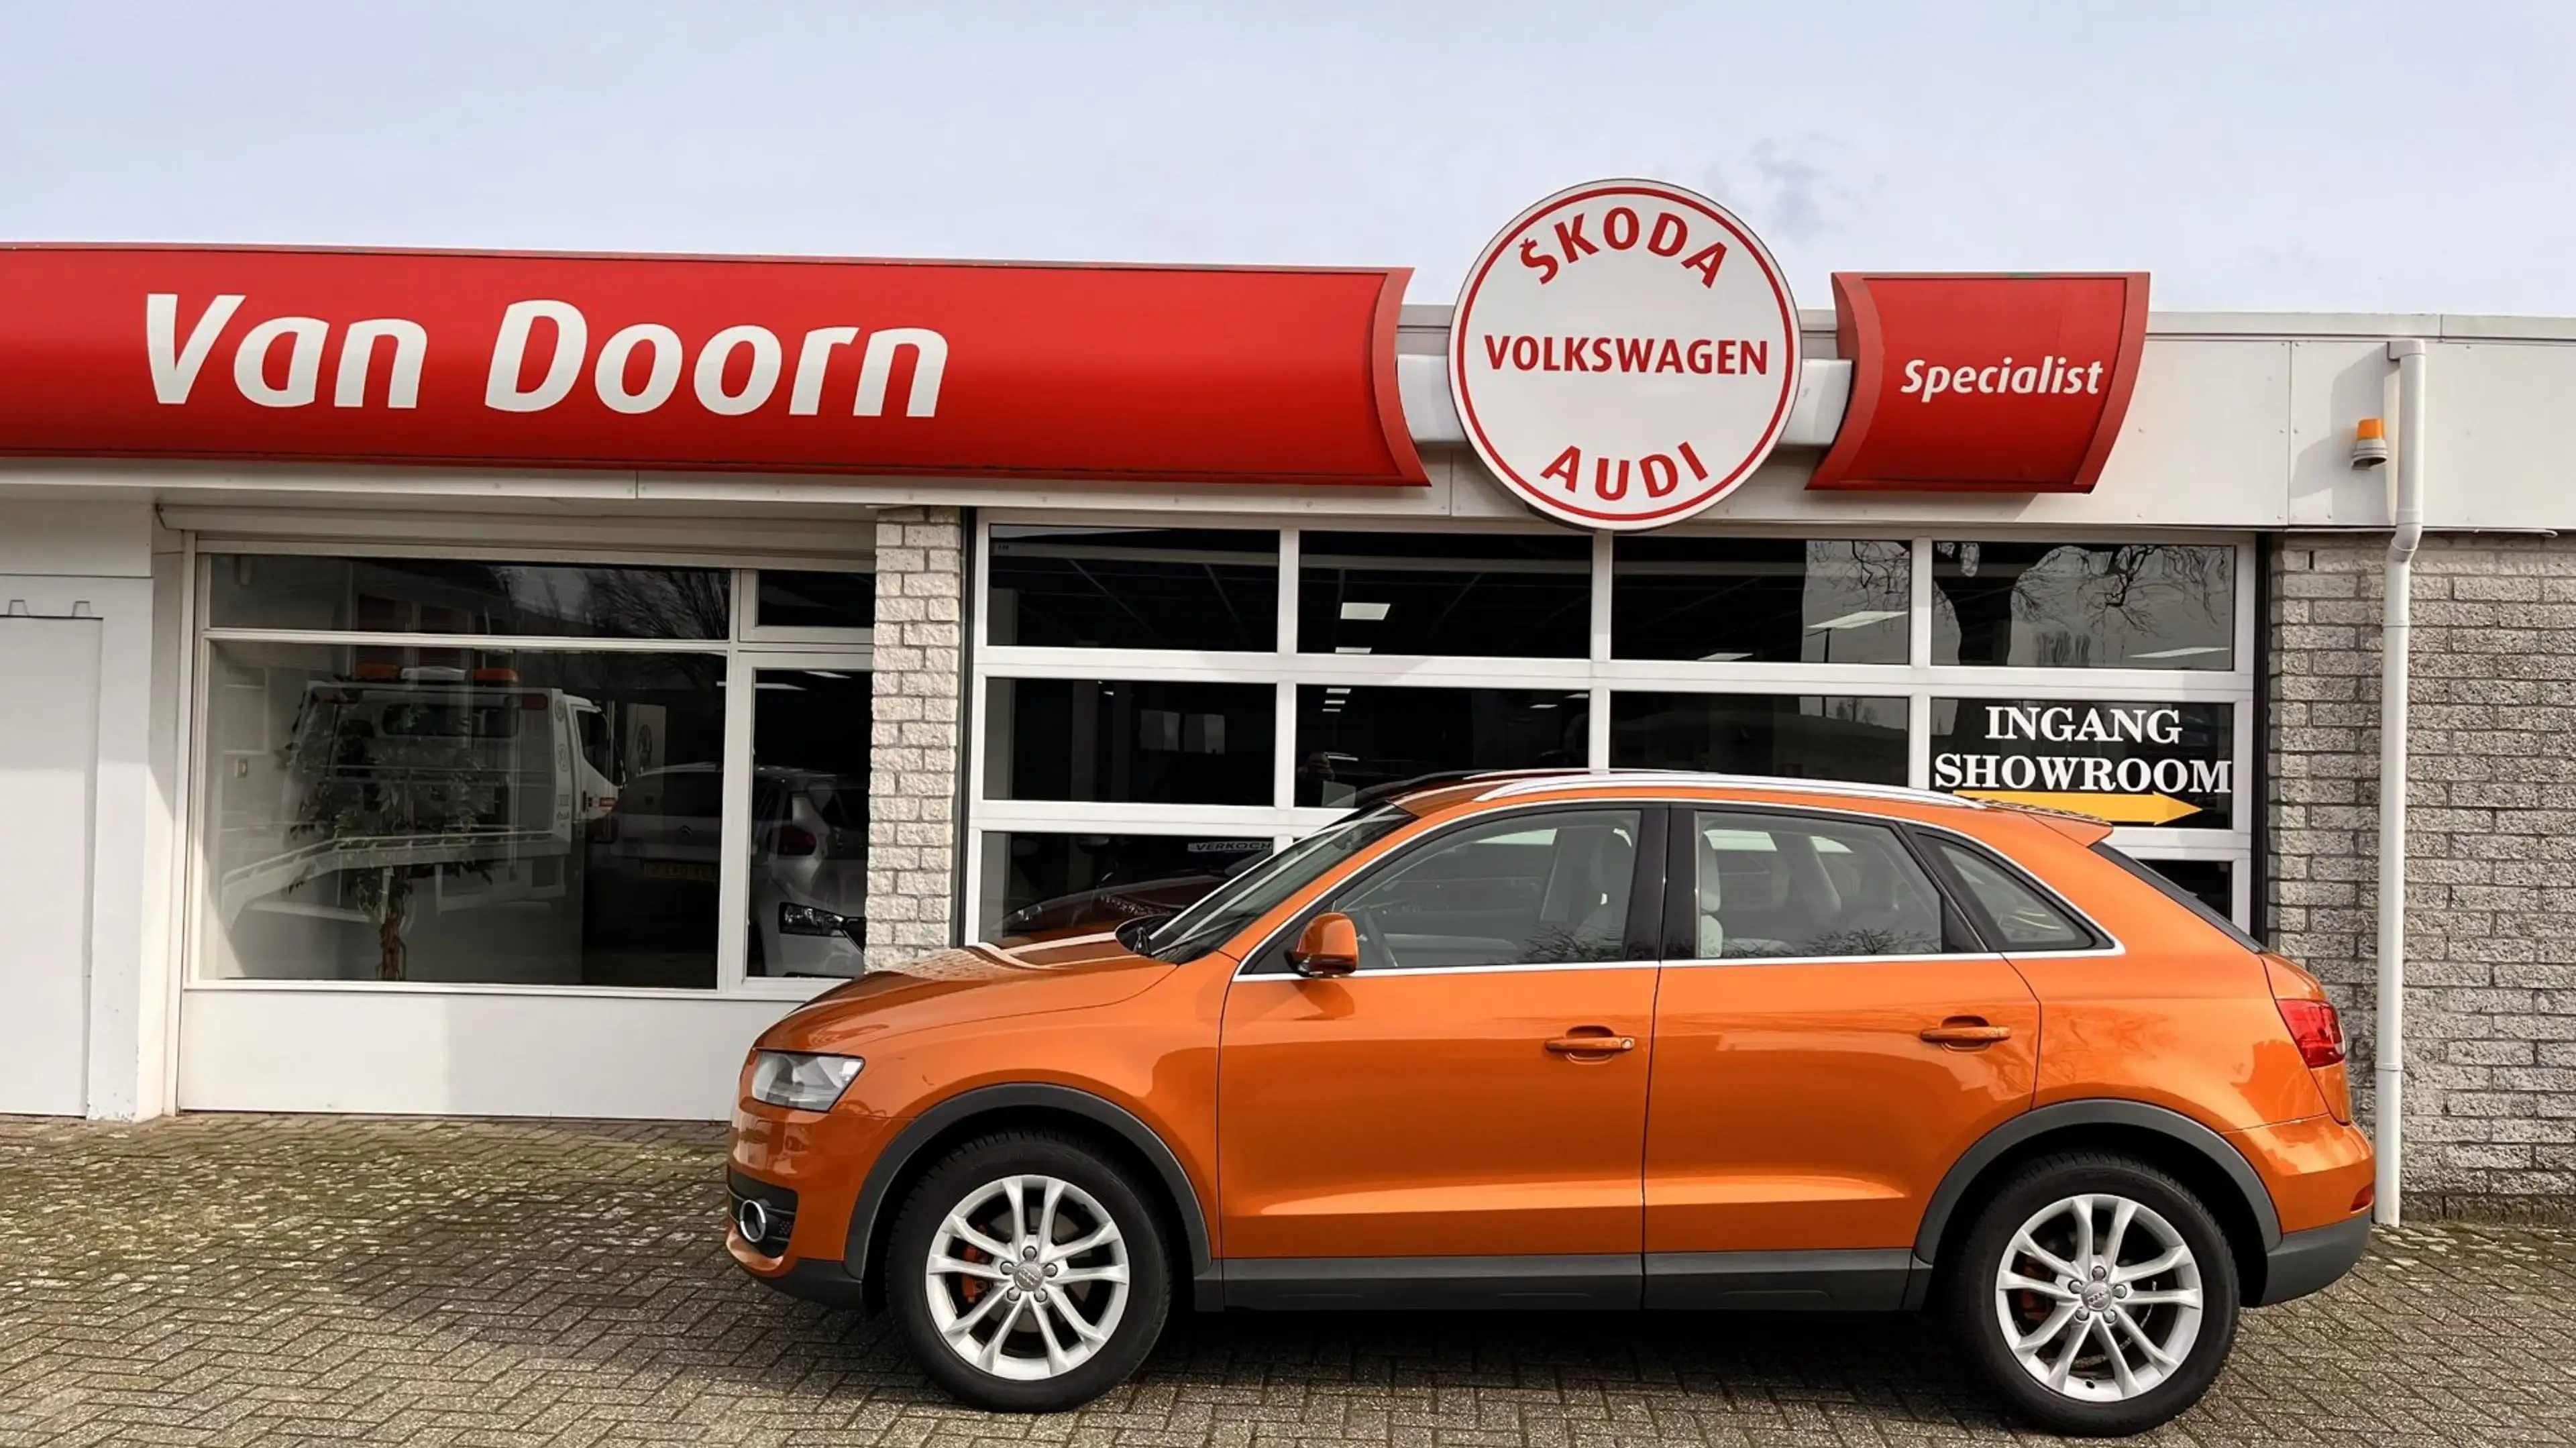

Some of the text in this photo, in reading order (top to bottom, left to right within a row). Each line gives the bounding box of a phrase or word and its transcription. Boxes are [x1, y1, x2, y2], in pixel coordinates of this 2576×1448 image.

[1519, 207, 1728, 288] ŠKODA
[147, 293, 949, 416] Van Doorn
[1484, 335, 1768, 375] VOLKSWAGEN
[1901, 355, 2104, 402] Specialist
[1540, 441, 1709, 501] AUDI
[1984, 706, 2183, 744] INGANG
[1935, 753, 2232, 793] SHOWROOM
